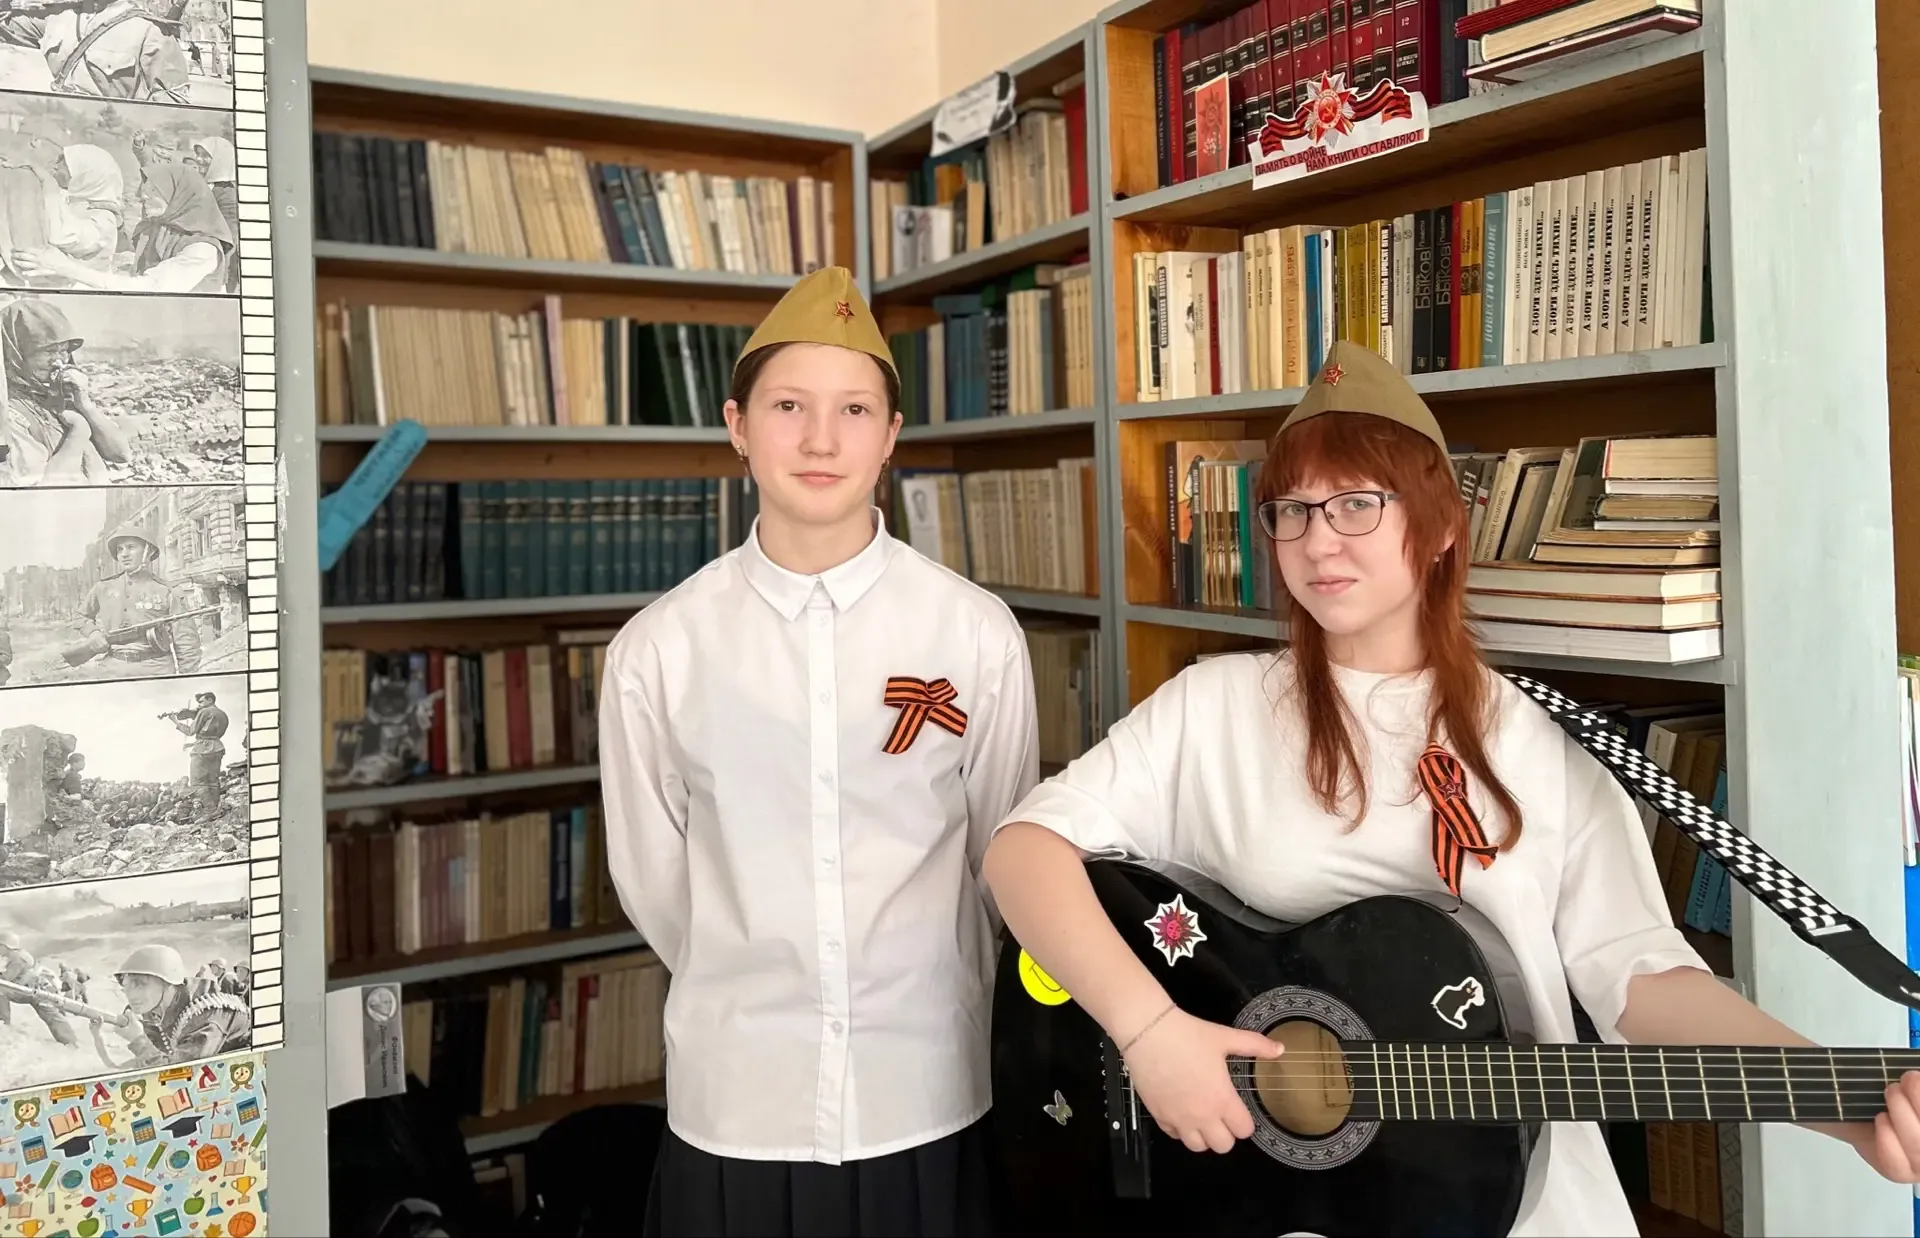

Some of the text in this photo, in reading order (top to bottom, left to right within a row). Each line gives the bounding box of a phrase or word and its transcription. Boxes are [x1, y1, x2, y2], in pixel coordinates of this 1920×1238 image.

[1401, 16, 1410, 27] 12
[1255, 146, 1327, 176] ПАМЯТЬ О ВОЙНЕ
[1306, 130, 1422, 173] НАМ КНИГИ ОСТАВЛЯЮТ
[1381, 229, 1389, 324] БАТАЛЬОНЫ ПРОСЯТ ОГНЯ
[1534, 260, 1542, 294] ЗДЕСЬ
[1551, 259, 1560, 293] ЗДЕСЬ
[1568, 257, 1577, 291] ЗДЕСЬ
[1585, 253, 1594, 288] ЗДЕСЬ
[1603, 250, 1612, 285] ЗДЕСЬ
[1624, 246, 1633, 282] ЗДЕСЬ
[1641, 243, 1651, 280] ЗДЕСЬ
[1485, 224, 1497, 342] ПОВЕСТИ О ВОЙНЕ
[1532, 297, 1540, 326] ЗОРИ
[1549, 296, 1558, 326] ЗОРИ
[1566, 293, 1575, 324] ЗОРИ
[1584, 291, 1592, 321] ЗОРИ
[1602, 288, 1610, 319] ЗОРИ
[1622, 285, 1630, 317] ЗОРИ
[1640, 283, 1648, 315] ЗОРИ
[1548, 328, 1557, 336] А
[1565, 326, 1574, 334] А
[1583, 323, 1591, 331] А
[1601, 321, 1609, 329] А
[1621, 319, 1629, 327] А
[1639, 317, 1647, 325] А
